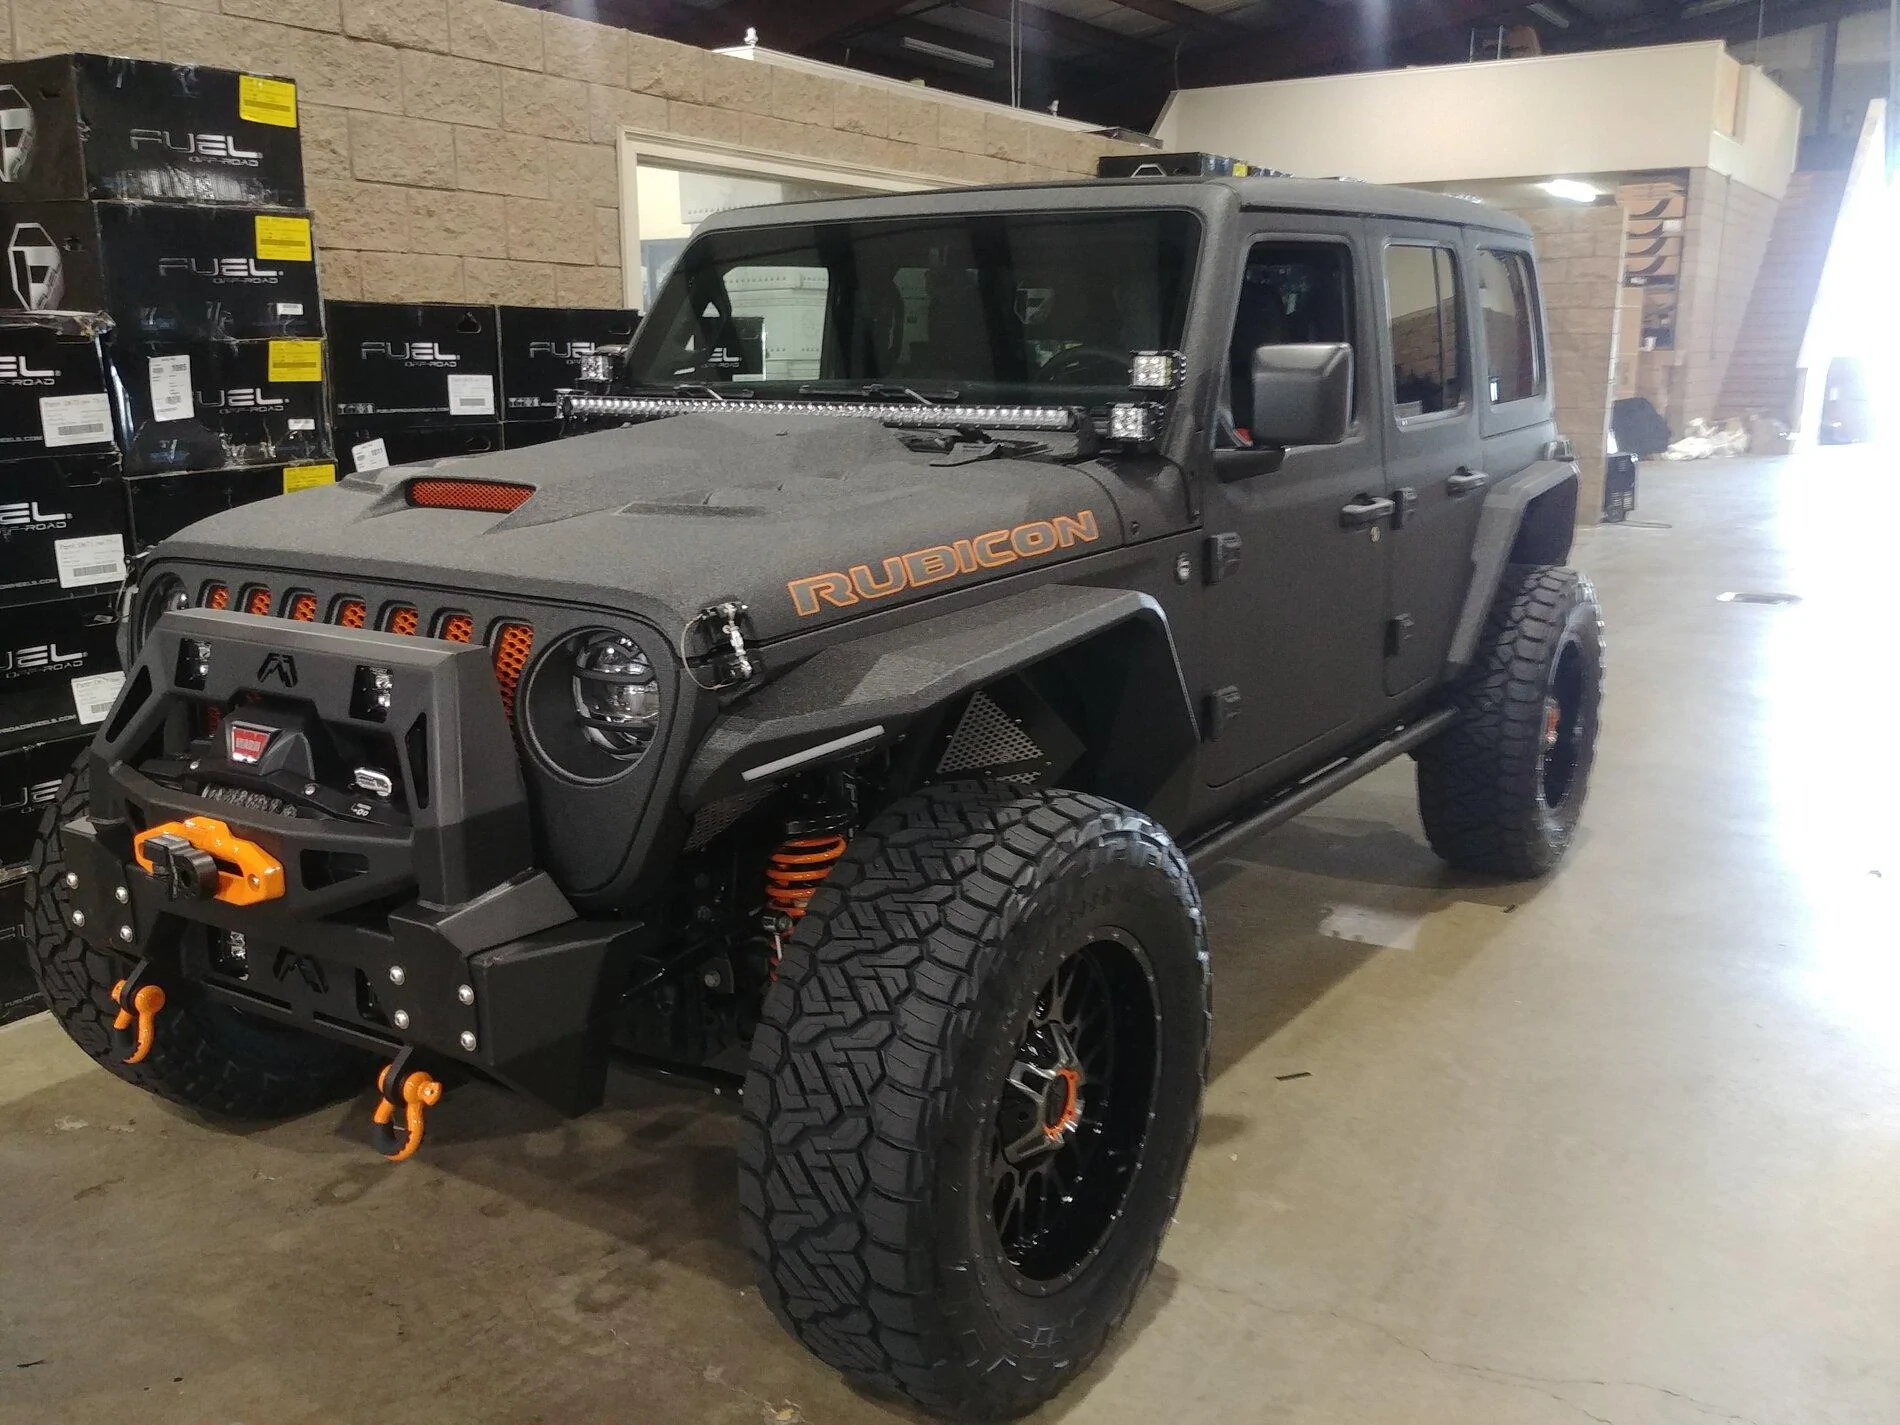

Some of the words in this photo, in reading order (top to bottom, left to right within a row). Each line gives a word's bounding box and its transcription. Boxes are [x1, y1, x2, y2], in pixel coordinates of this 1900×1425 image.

[130, 128, 263, 158] FUEL
[159, 258, 278, 276] FUEL
[360, 342, 460, 360] FUEL
[192, 387, 284, 407] UEL
[787, 509, 1100, 617] RUBICON
